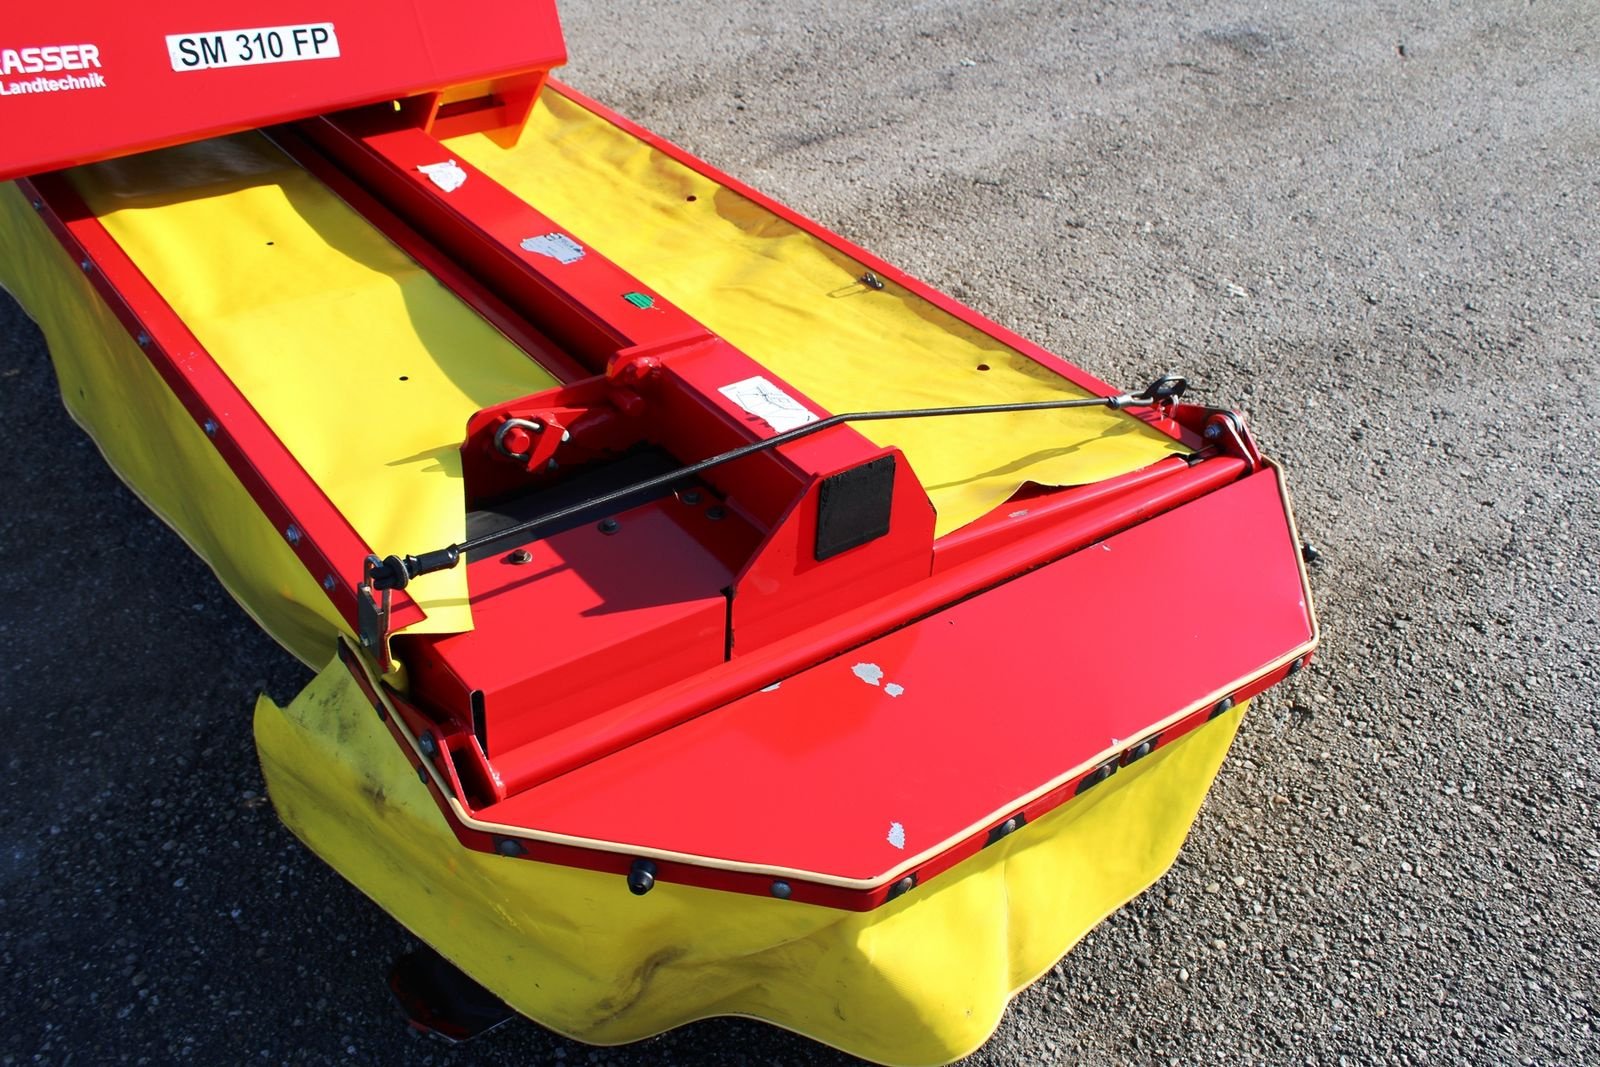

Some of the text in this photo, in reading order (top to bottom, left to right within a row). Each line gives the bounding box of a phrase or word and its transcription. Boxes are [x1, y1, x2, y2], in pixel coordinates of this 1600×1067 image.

[0, 43, 102, 76] ASSER
[178, 36, 228, 67] SM
[235, 31, 284, 61] 310
[292, 27, 329, 56] FP
[0, 72, 106, 95] Landtechnik
